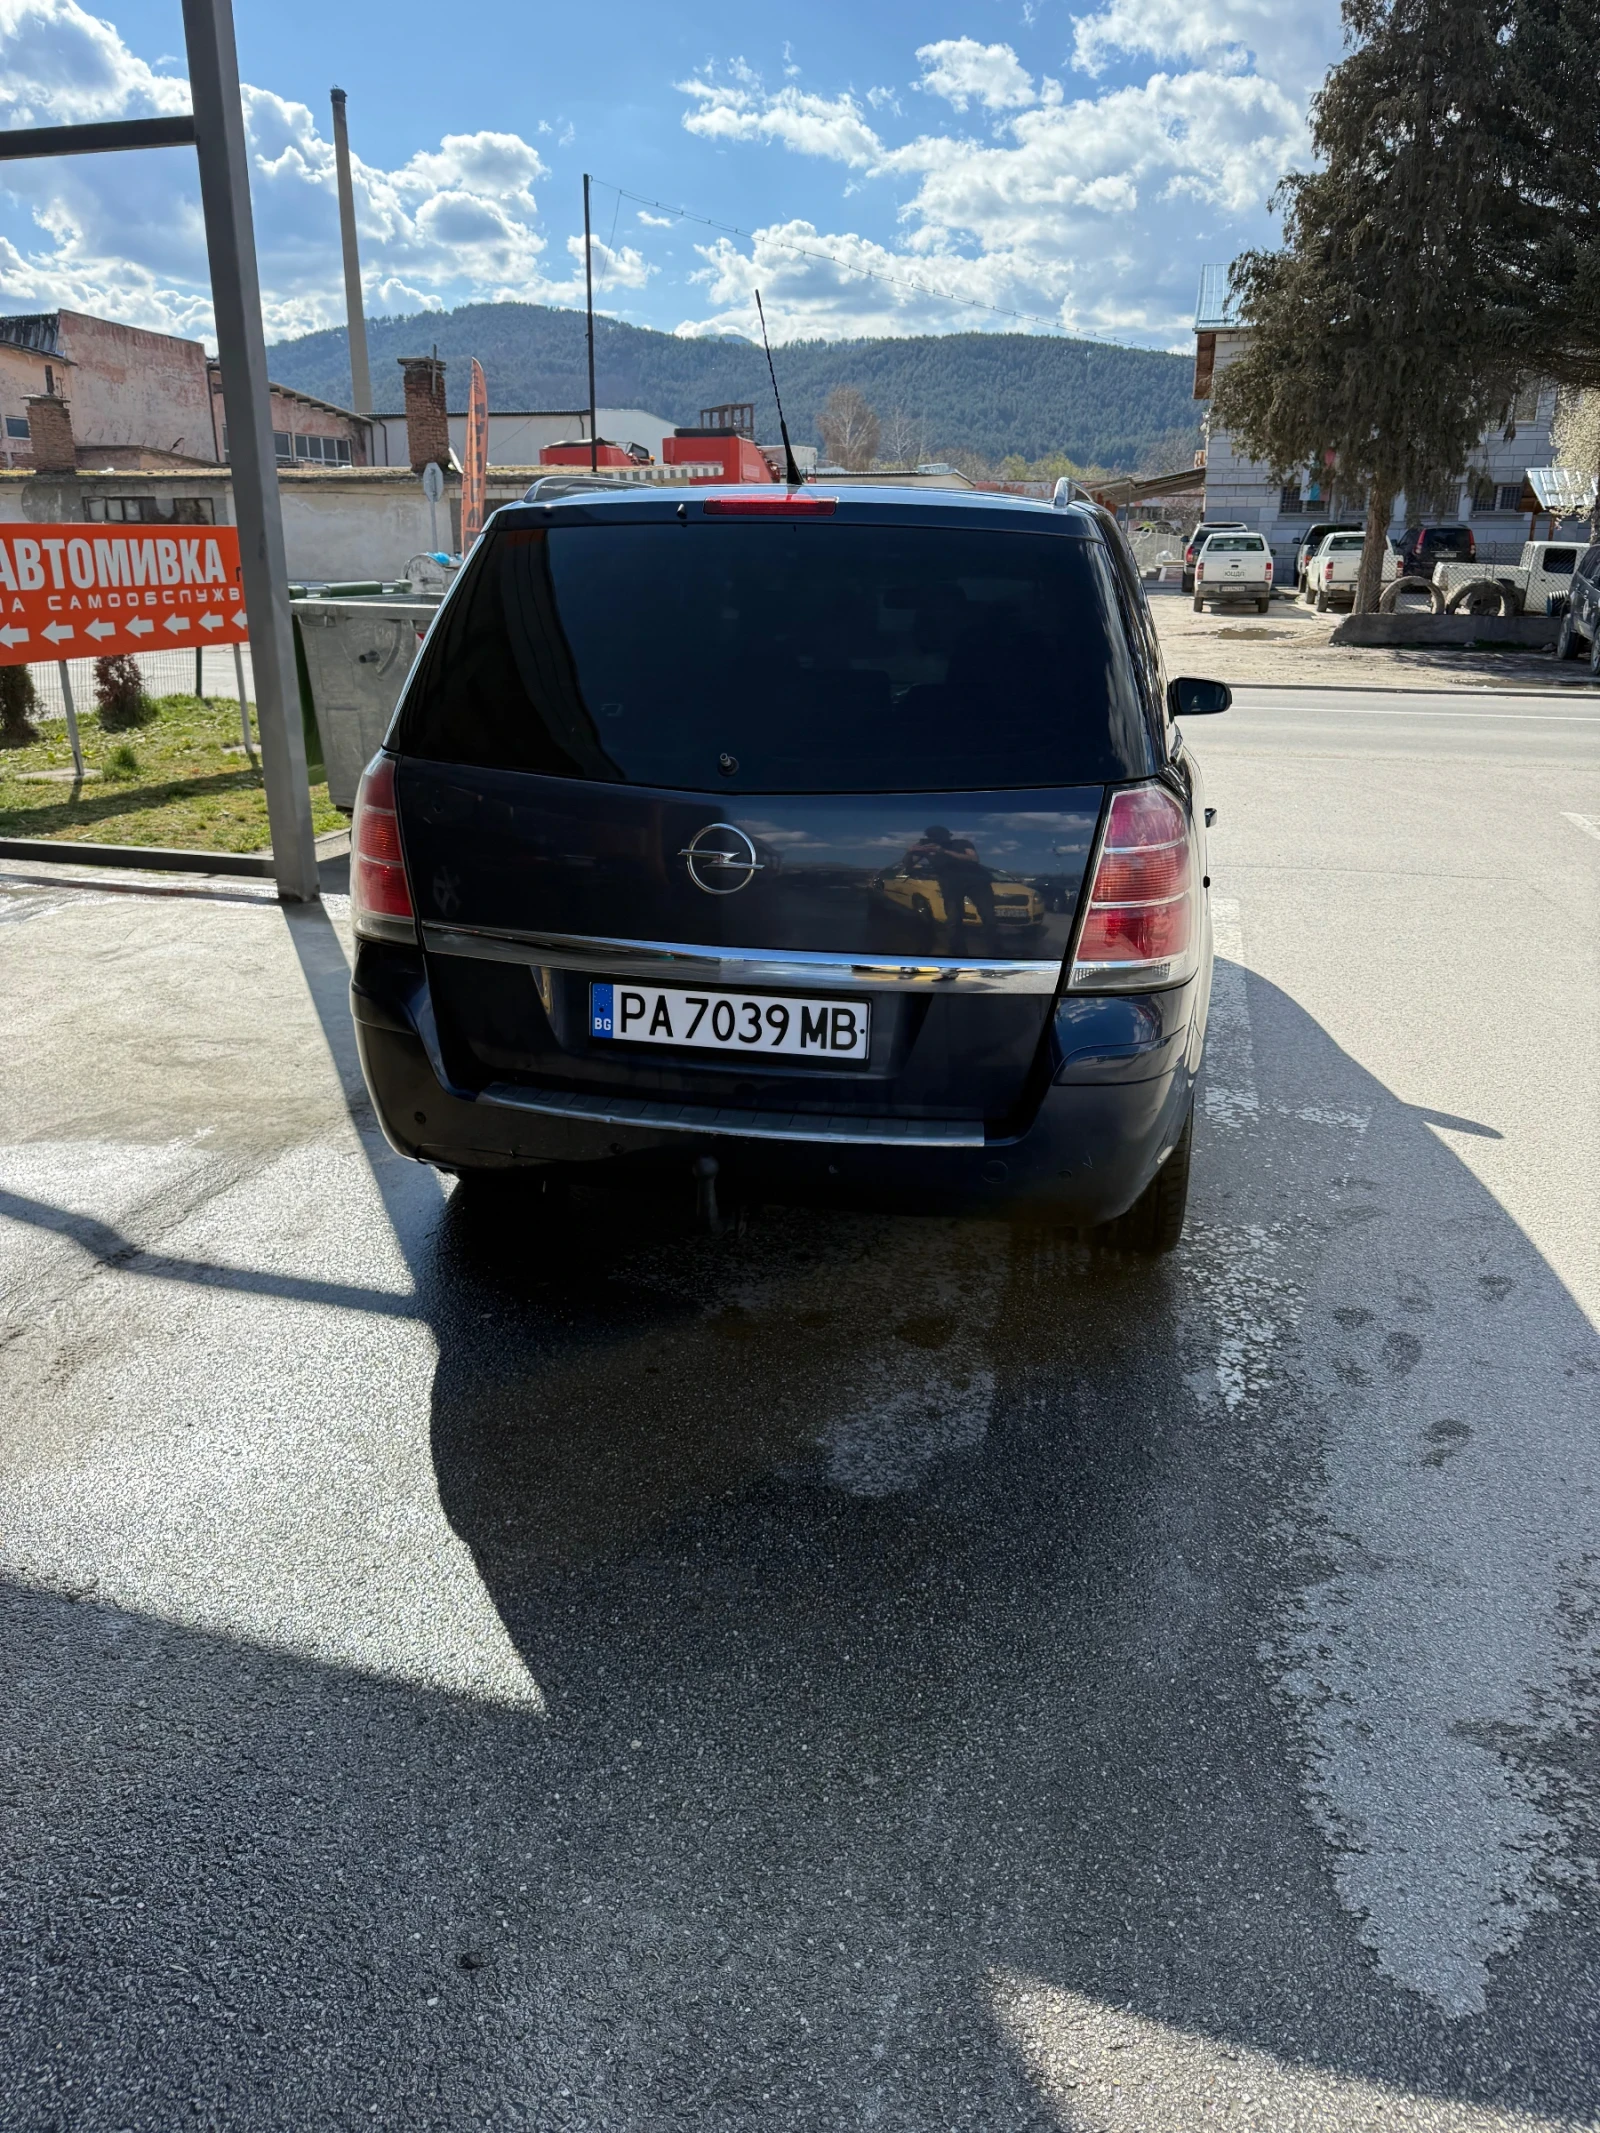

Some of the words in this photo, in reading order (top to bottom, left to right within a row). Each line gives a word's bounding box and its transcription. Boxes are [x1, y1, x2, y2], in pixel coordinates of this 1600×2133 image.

[0, 538, 227, 591] АВТОМИВКА
[594, 1017, 611, 1031] BG
[620, 992, 673, 1037] PA
[685, 997, 790, 1046] 7039
[800, 1006, 857, 1050] MB
